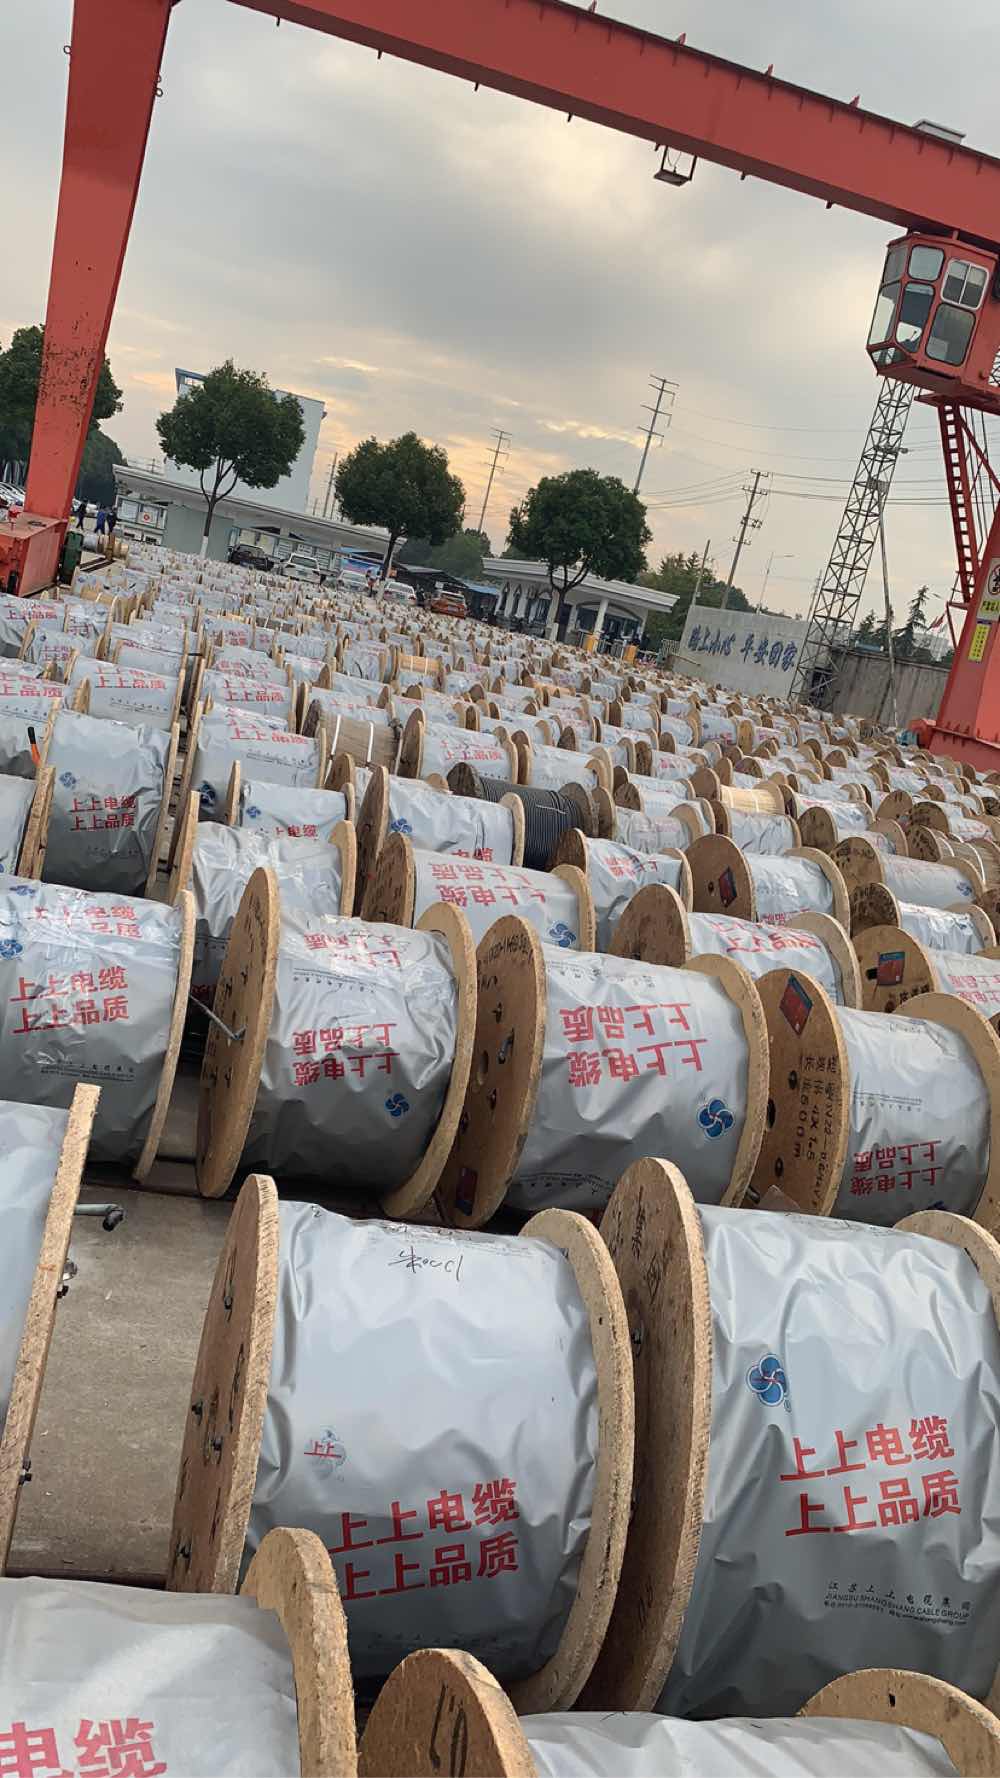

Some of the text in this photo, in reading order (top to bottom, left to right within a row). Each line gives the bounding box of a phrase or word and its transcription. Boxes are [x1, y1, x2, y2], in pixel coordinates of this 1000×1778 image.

[69, 796, 137, 813] 上上电缆
[69, 814, 135, 831] 上上品质
[10, 966, 128, 1002] 上上电缆
[13, 996, 129, 1034] 上上品质
[560, 1003, 690, 1042] 上上品质
[293, 1024, 398, 1055] 上上品质
[293, 1053, 401, 1086] 上上电缆
[567, 1039, 708, 1088] 上上电缆
[854, 1140, 942, 1172] 上上品质
[850, 1167, 944, 1196] 上上电缆
[779, 1415, 955, 1481] 上上电缆
[329, 1478, 520, 1553] 上上电缆
[785, 1469, 961, 1536] 上上品质
[341, 1531, 519, 1600] 上上品质
